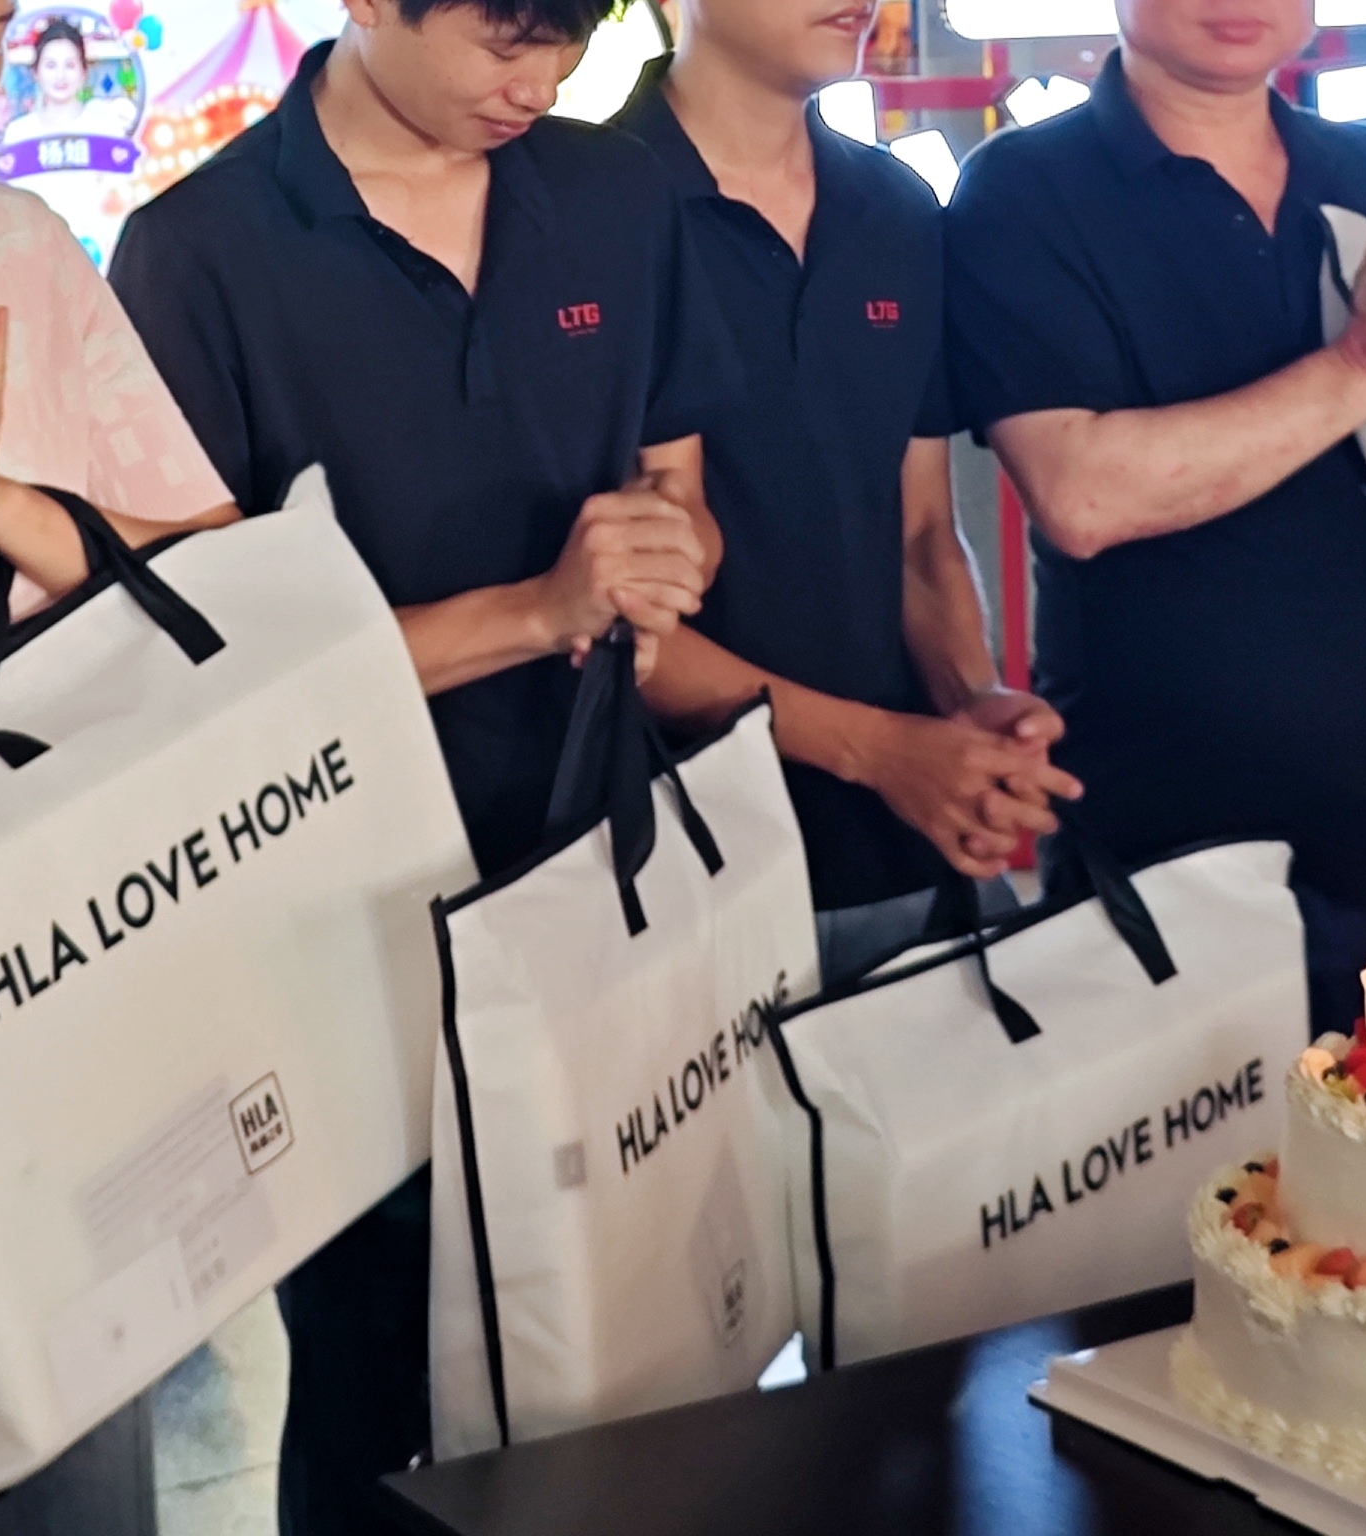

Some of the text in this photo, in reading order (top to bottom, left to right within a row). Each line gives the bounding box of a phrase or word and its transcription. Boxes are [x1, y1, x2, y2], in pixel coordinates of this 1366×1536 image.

[557, 302, 601, 330] LTG
[865, 300, 900, 321] LTG
[86, 826, 219, 951] LOVE
[219, 736, 355, 864] HOME
[239, 1090, 280, 1139] HLA
[616, 1087, 670, 1177] HLA
[668, 1029, 731, 1126] LOVE
[979, 1056, 1265, 1249] HLA LOVE HOME
